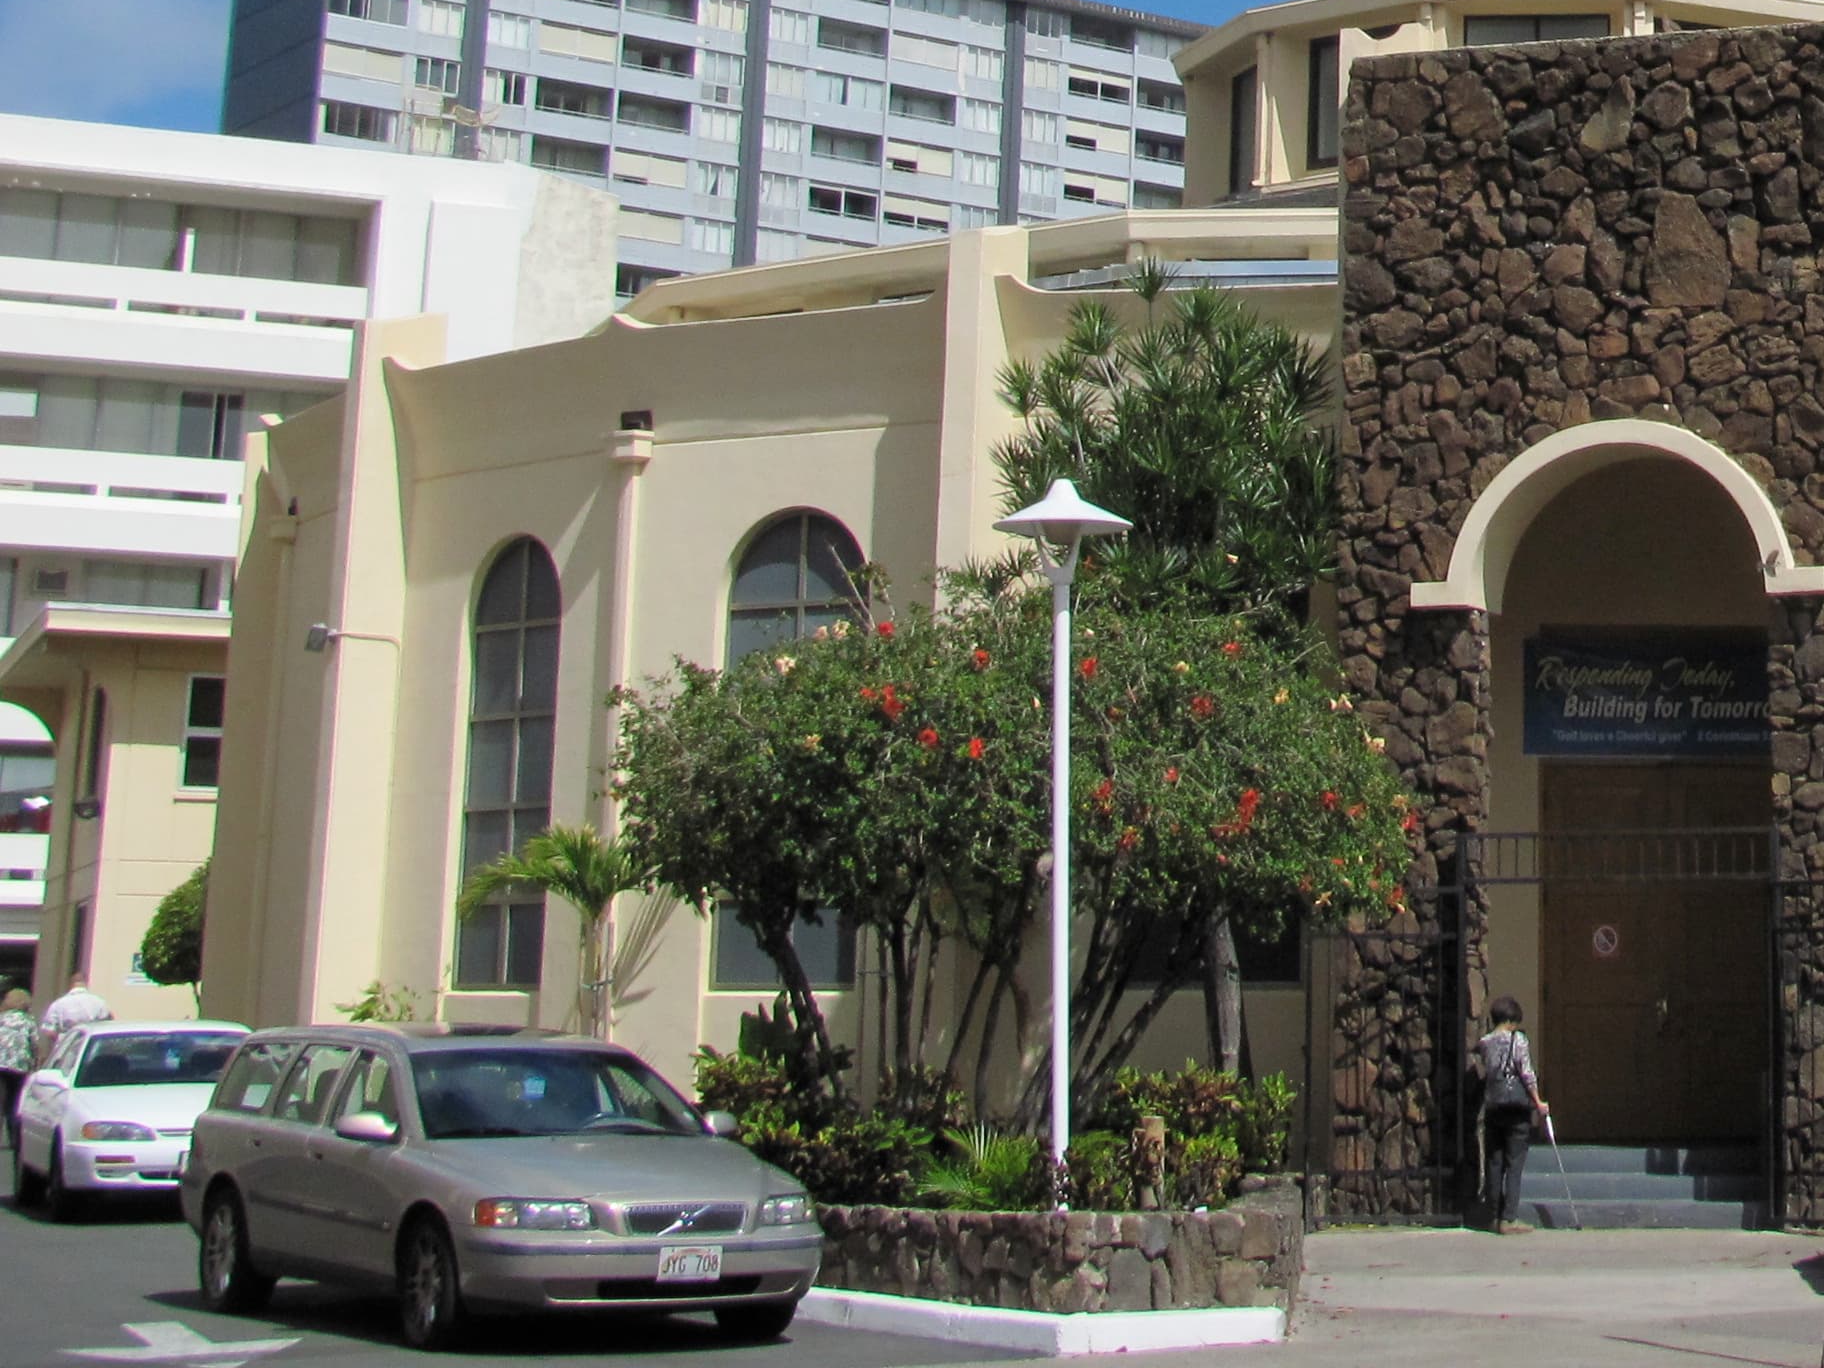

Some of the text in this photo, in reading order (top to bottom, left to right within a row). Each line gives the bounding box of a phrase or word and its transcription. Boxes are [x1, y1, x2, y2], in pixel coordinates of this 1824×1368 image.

[1563, 695, 1771, 723] Building for Tomorro
[695, 1254, 719, 1273] 708
